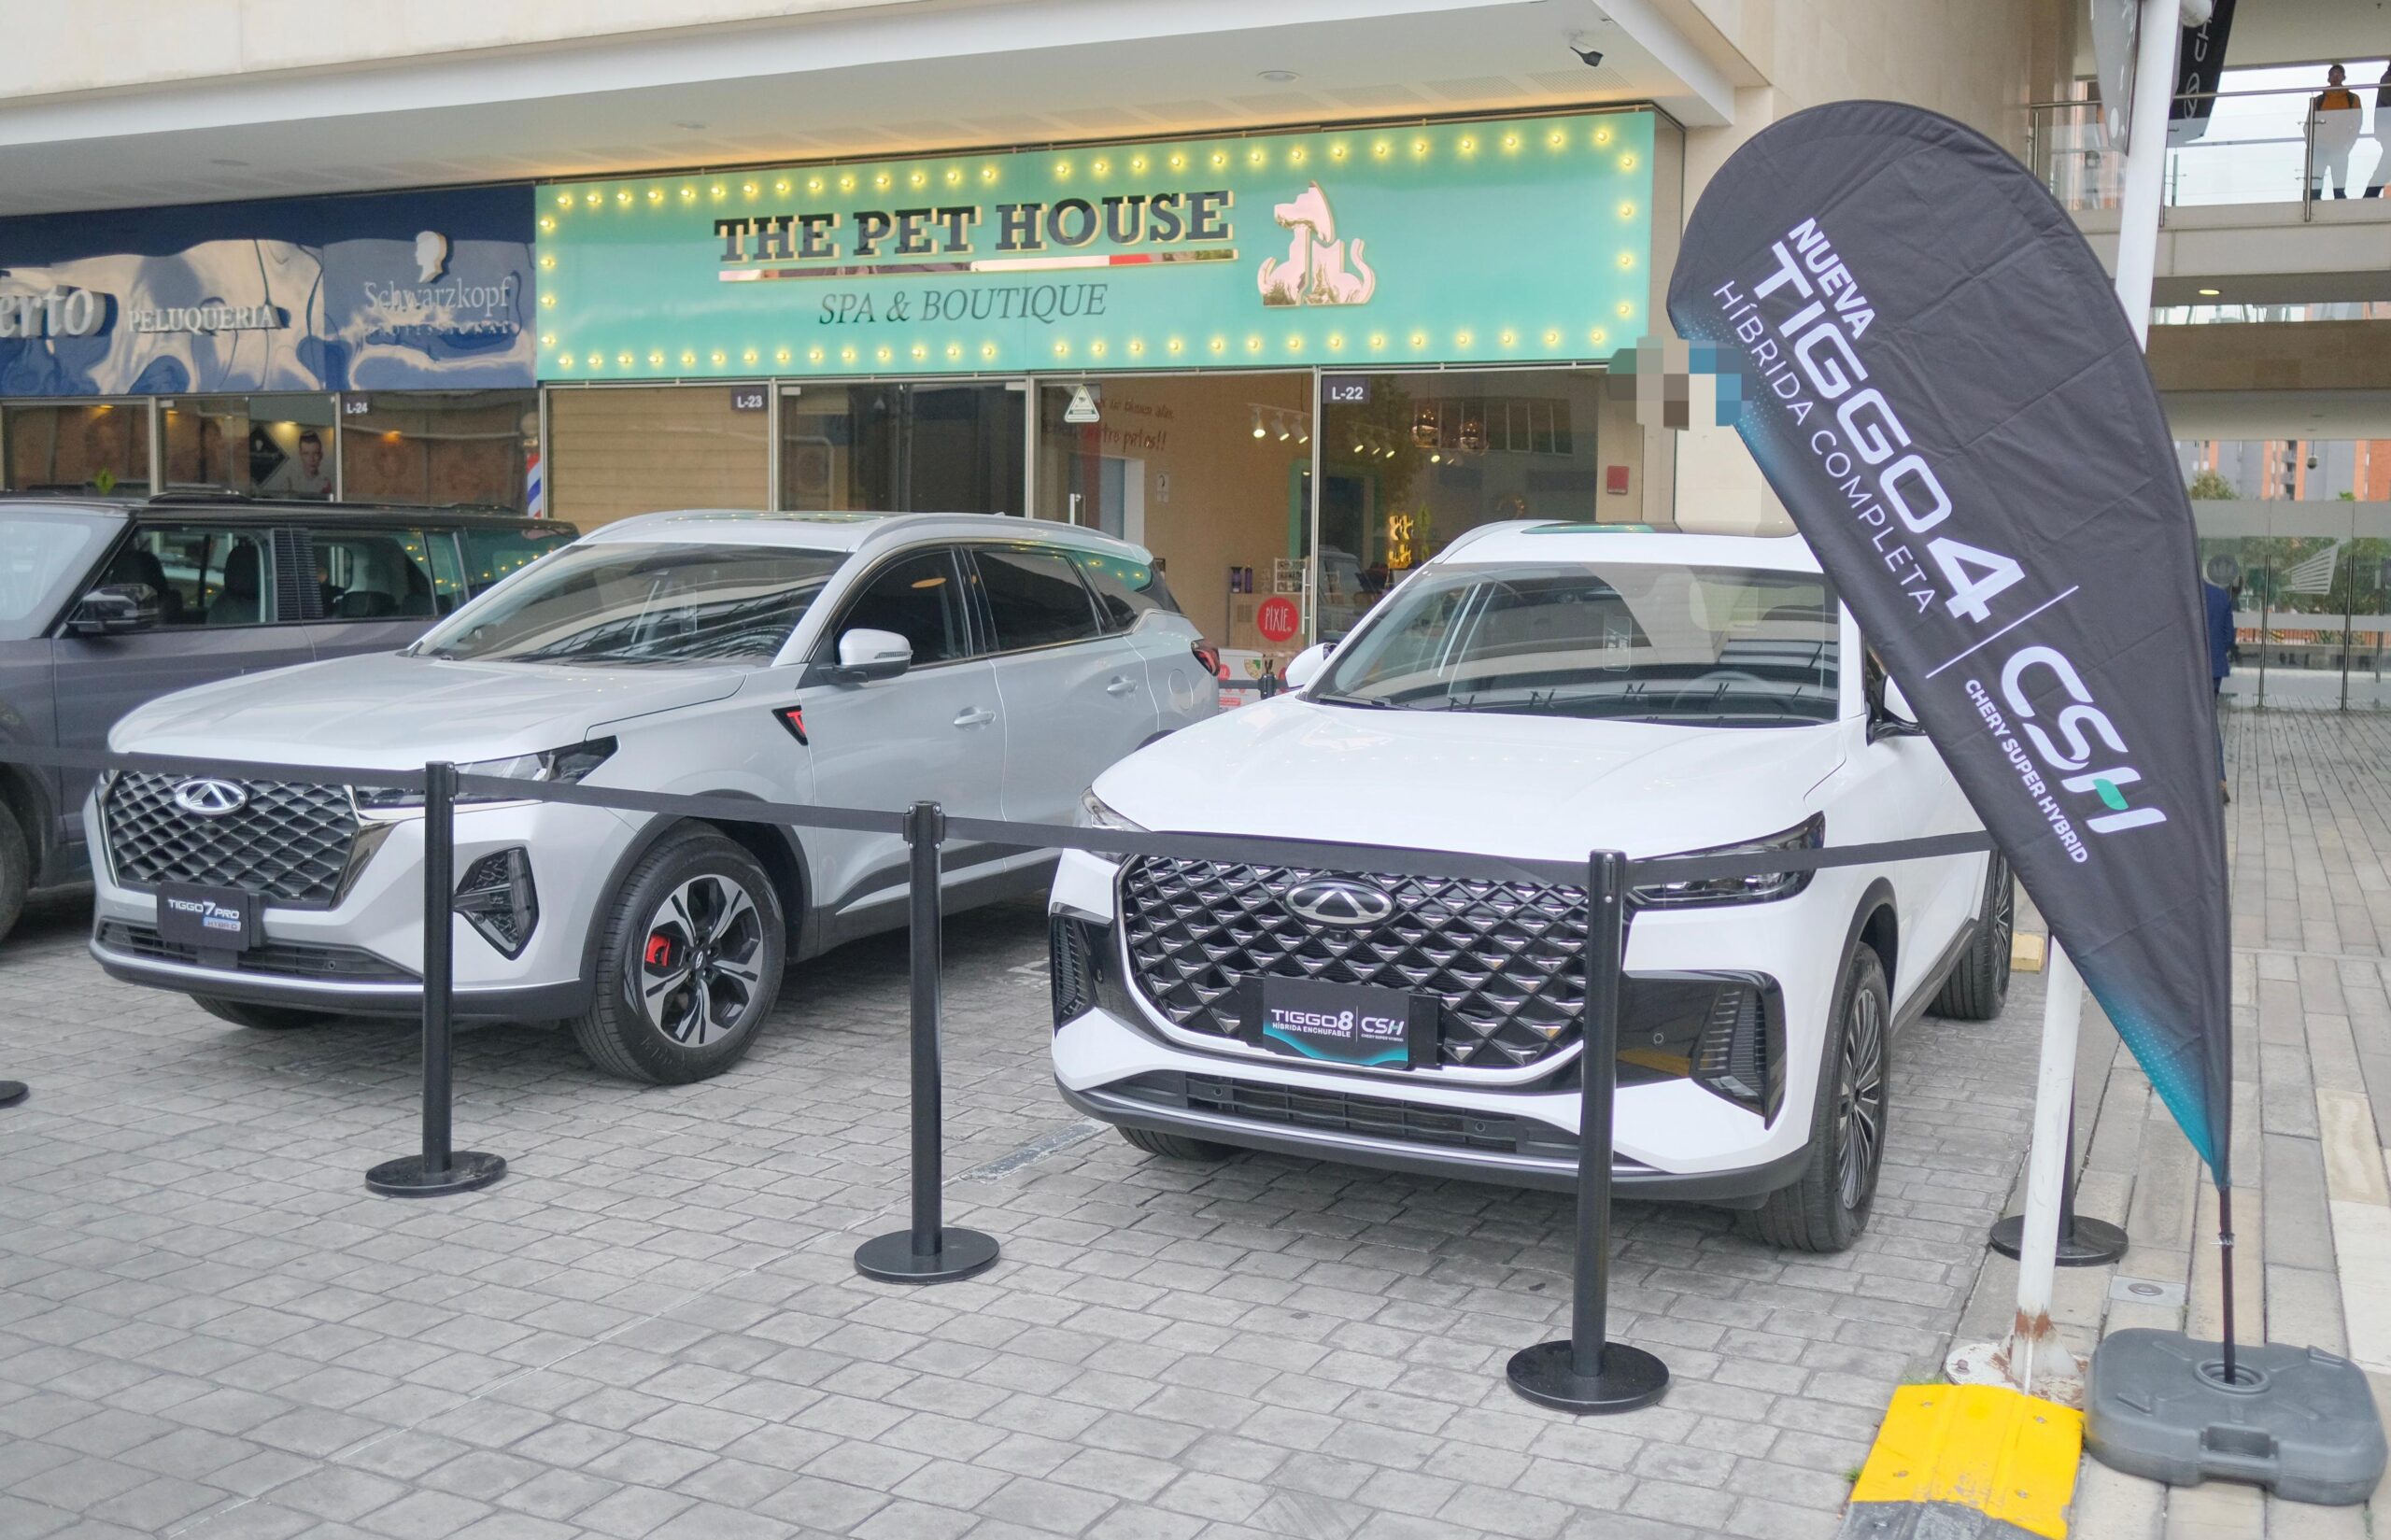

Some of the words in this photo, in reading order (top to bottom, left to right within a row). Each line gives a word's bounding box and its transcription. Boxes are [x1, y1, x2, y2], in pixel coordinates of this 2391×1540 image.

[714, 211, 841, 262] THE
[853, 205, 982, 257] PET
[995, 190, 1235, 251] HOUSE
[1788, 217, 1877, 340] NUEVA
[364, 276, 512, 318] Schwarzkopf
[819, 291, 876, 325] SPA
[886, 287, 911, 322] &
[919, 283, 1109, 321] BOUTIQUE
[128, 304, 276, 335] PELUQUERIA
[347, 403, 368, 414] L-24
[737, 395, 763, 408] L-23
[1332, 386, 1364, 401] L-22
[1712, 280, 1815, 427] HÍBRIDA
[1810, 429, 1937, 615] COMPLETA
[1265, 605, 1289, 631] PIXIE
[2002, 645, 2168, 834] CSH
[1965, 679, 2011, 738] CHERY
[2002, 738, 2047, 798] SUPER
[2038, 796, 2088, 863] HYBRID
[1272, 1022, 1303, 1032] HÍBRIDA
[1303, 1025, 1351, 1038] ENCHUFABLE
[1361, 1016, 1405, 1036] CSH
